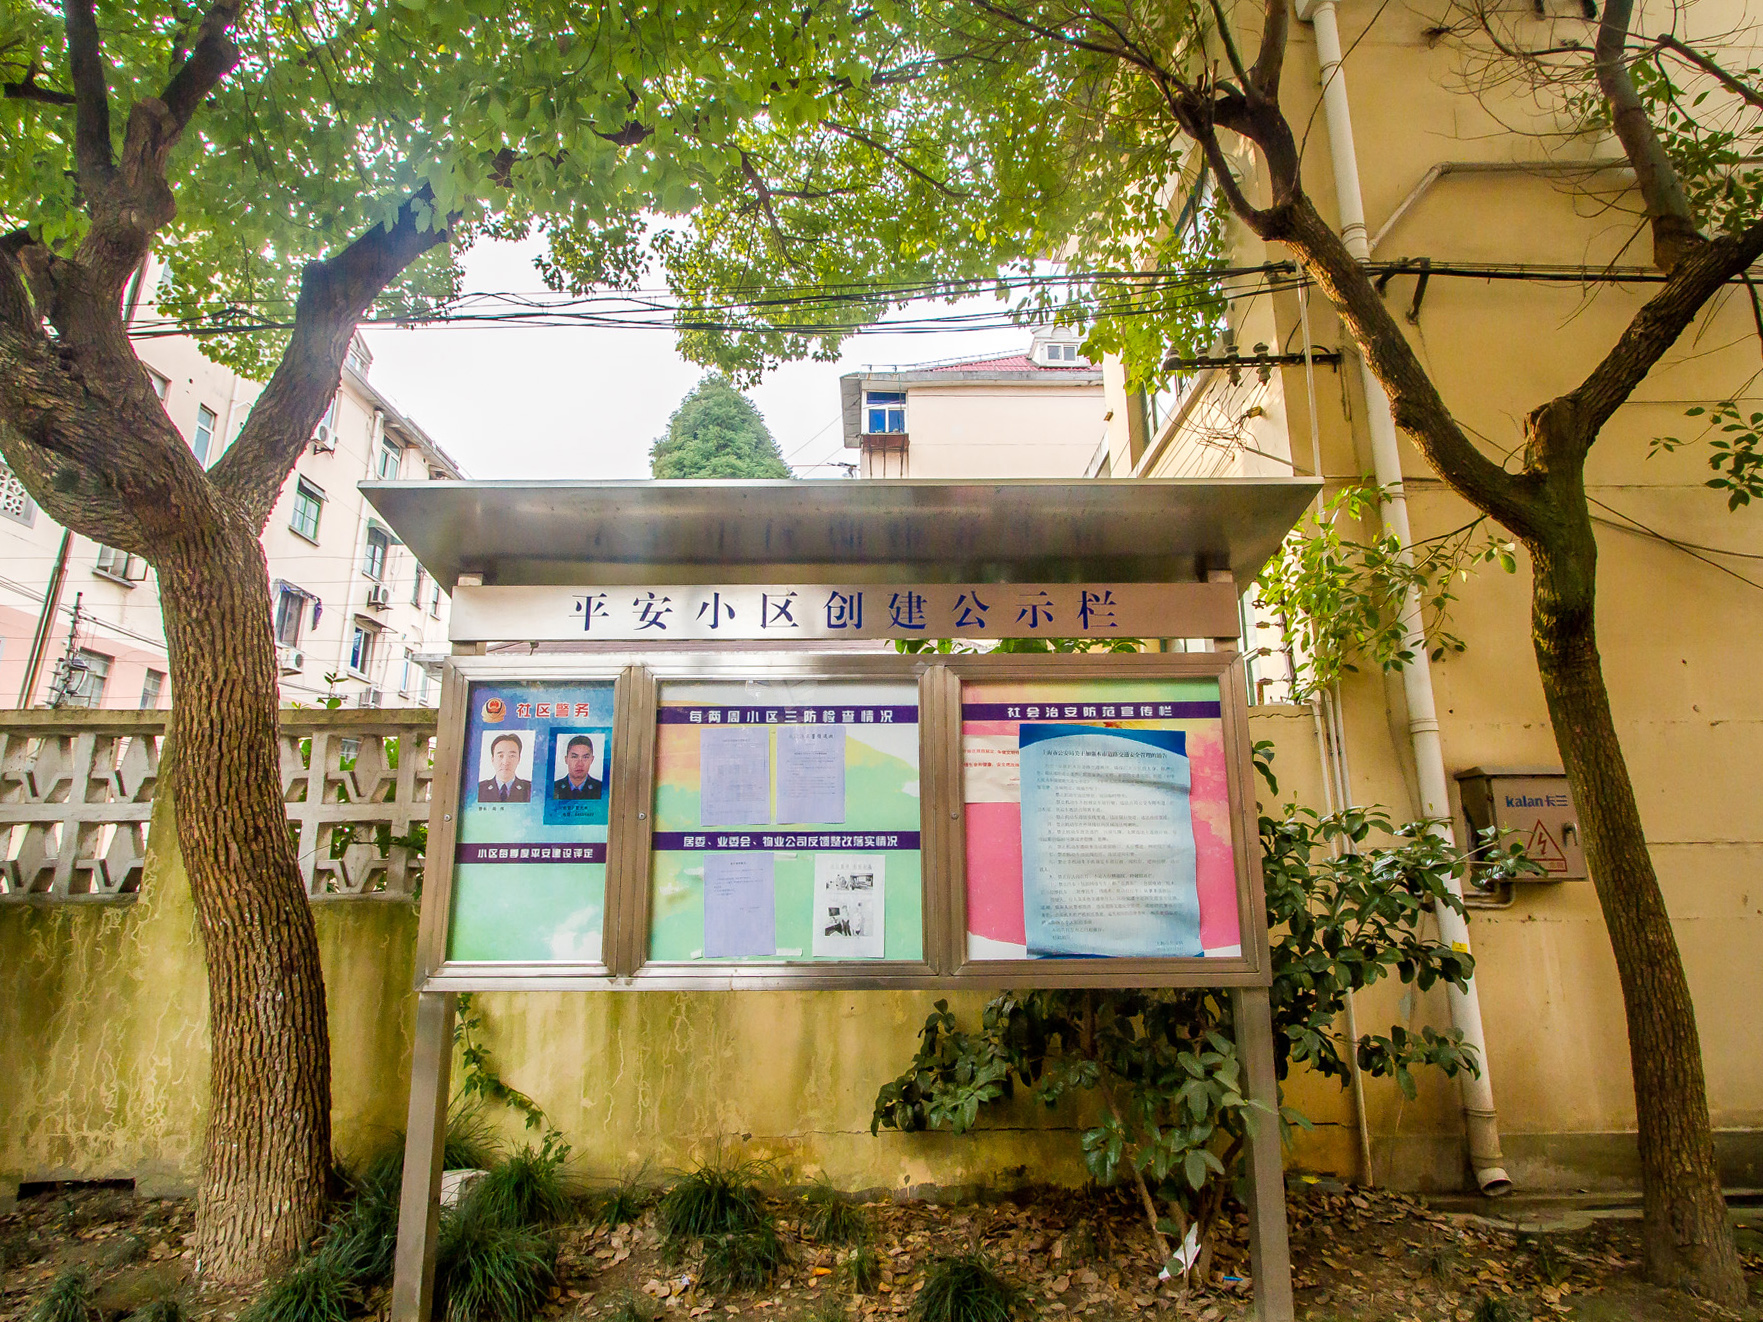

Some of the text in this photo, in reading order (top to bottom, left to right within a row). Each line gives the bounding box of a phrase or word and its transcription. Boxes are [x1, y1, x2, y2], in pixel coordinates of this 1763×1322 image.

[570, 591, 1119, 631] 平安小区创建公示栏
[516, 703, 590, 718] 社区警务
[689, 710, 894, 724] 每两周小区三防检查情况
[1007, 704, 1173, 718] 社会治安防范宣传栏
[683, 835, 898, 848] 居委、业委会、物业公司反馈整改落实情况
[477, 848, 594, 859] 小区每季度平安建设评定
